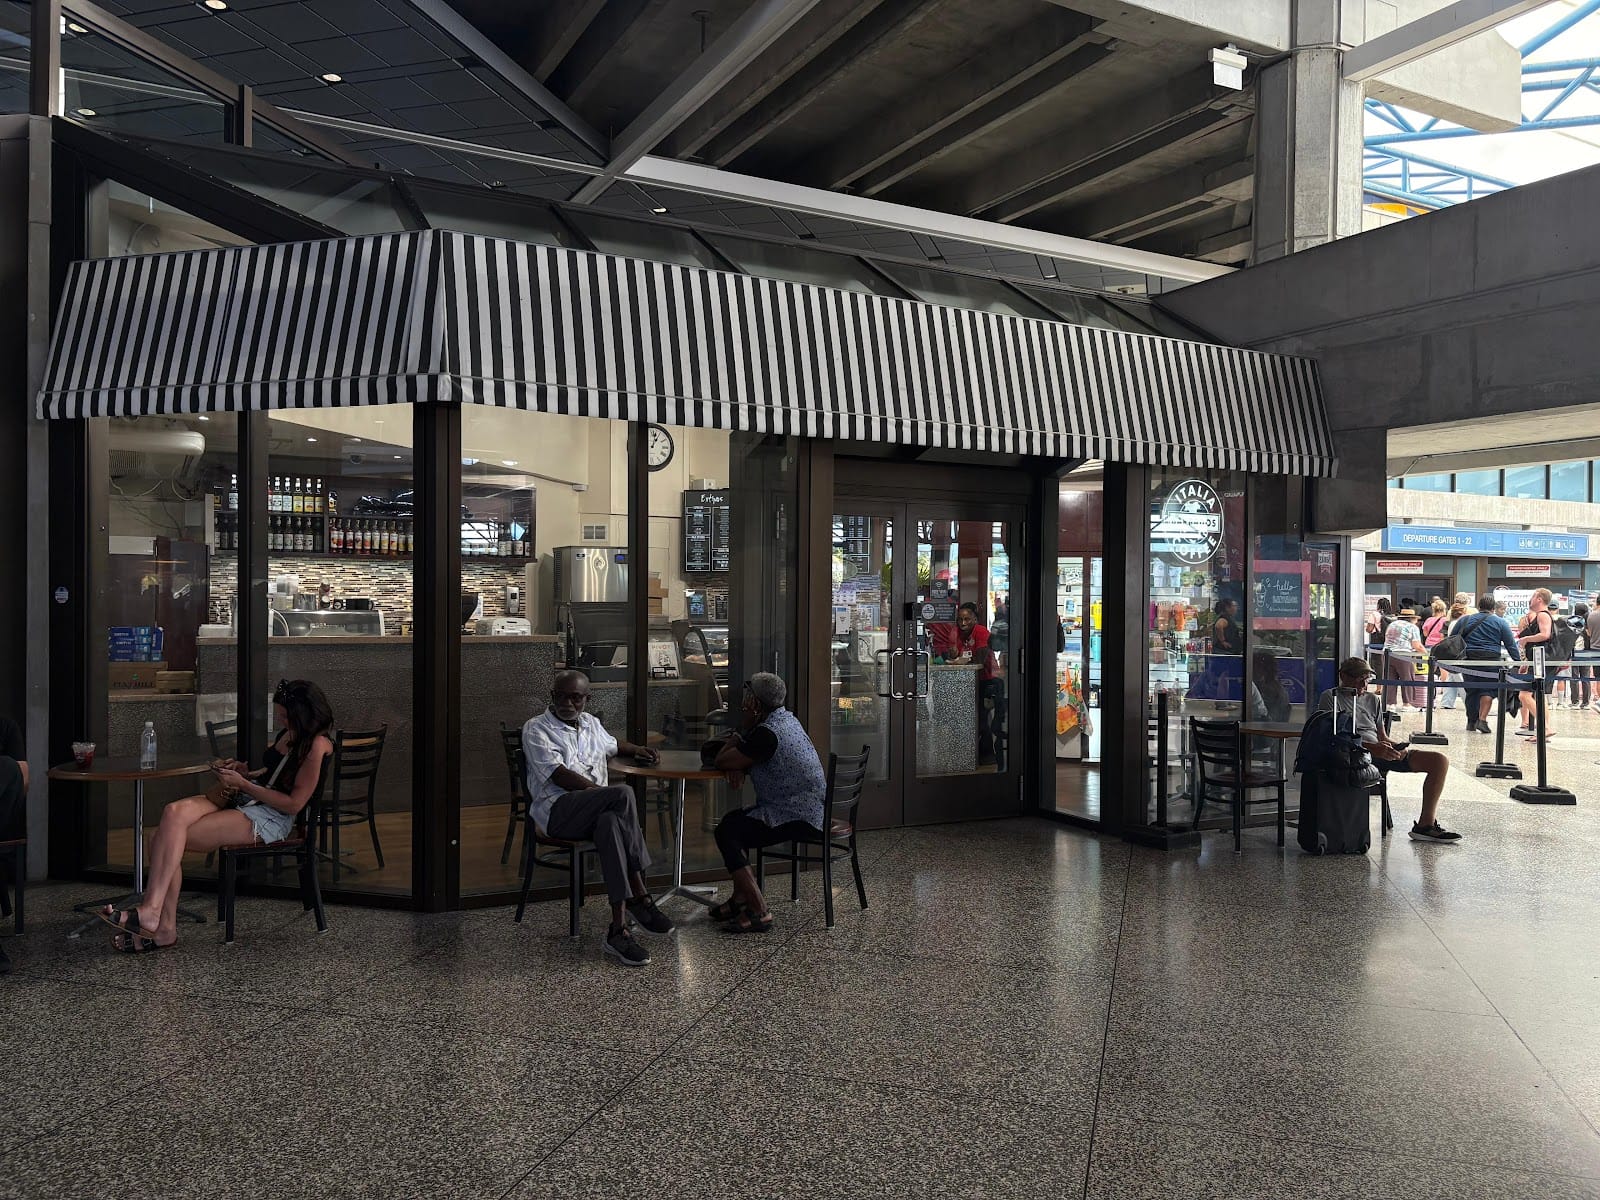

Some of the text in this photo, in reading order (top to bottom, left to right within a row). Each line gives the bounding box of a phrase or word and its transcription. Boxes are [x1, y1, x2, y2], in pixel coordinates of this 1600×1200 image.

[1174, 485, 1216, 509] ITALIA
[1403, 533, 1438, 544] DEPARTURE
[1438, 535, 1457, 545] GATES
[1465, 537, 1473, 545] 22
[1272, 580, 1298, 591] hello
